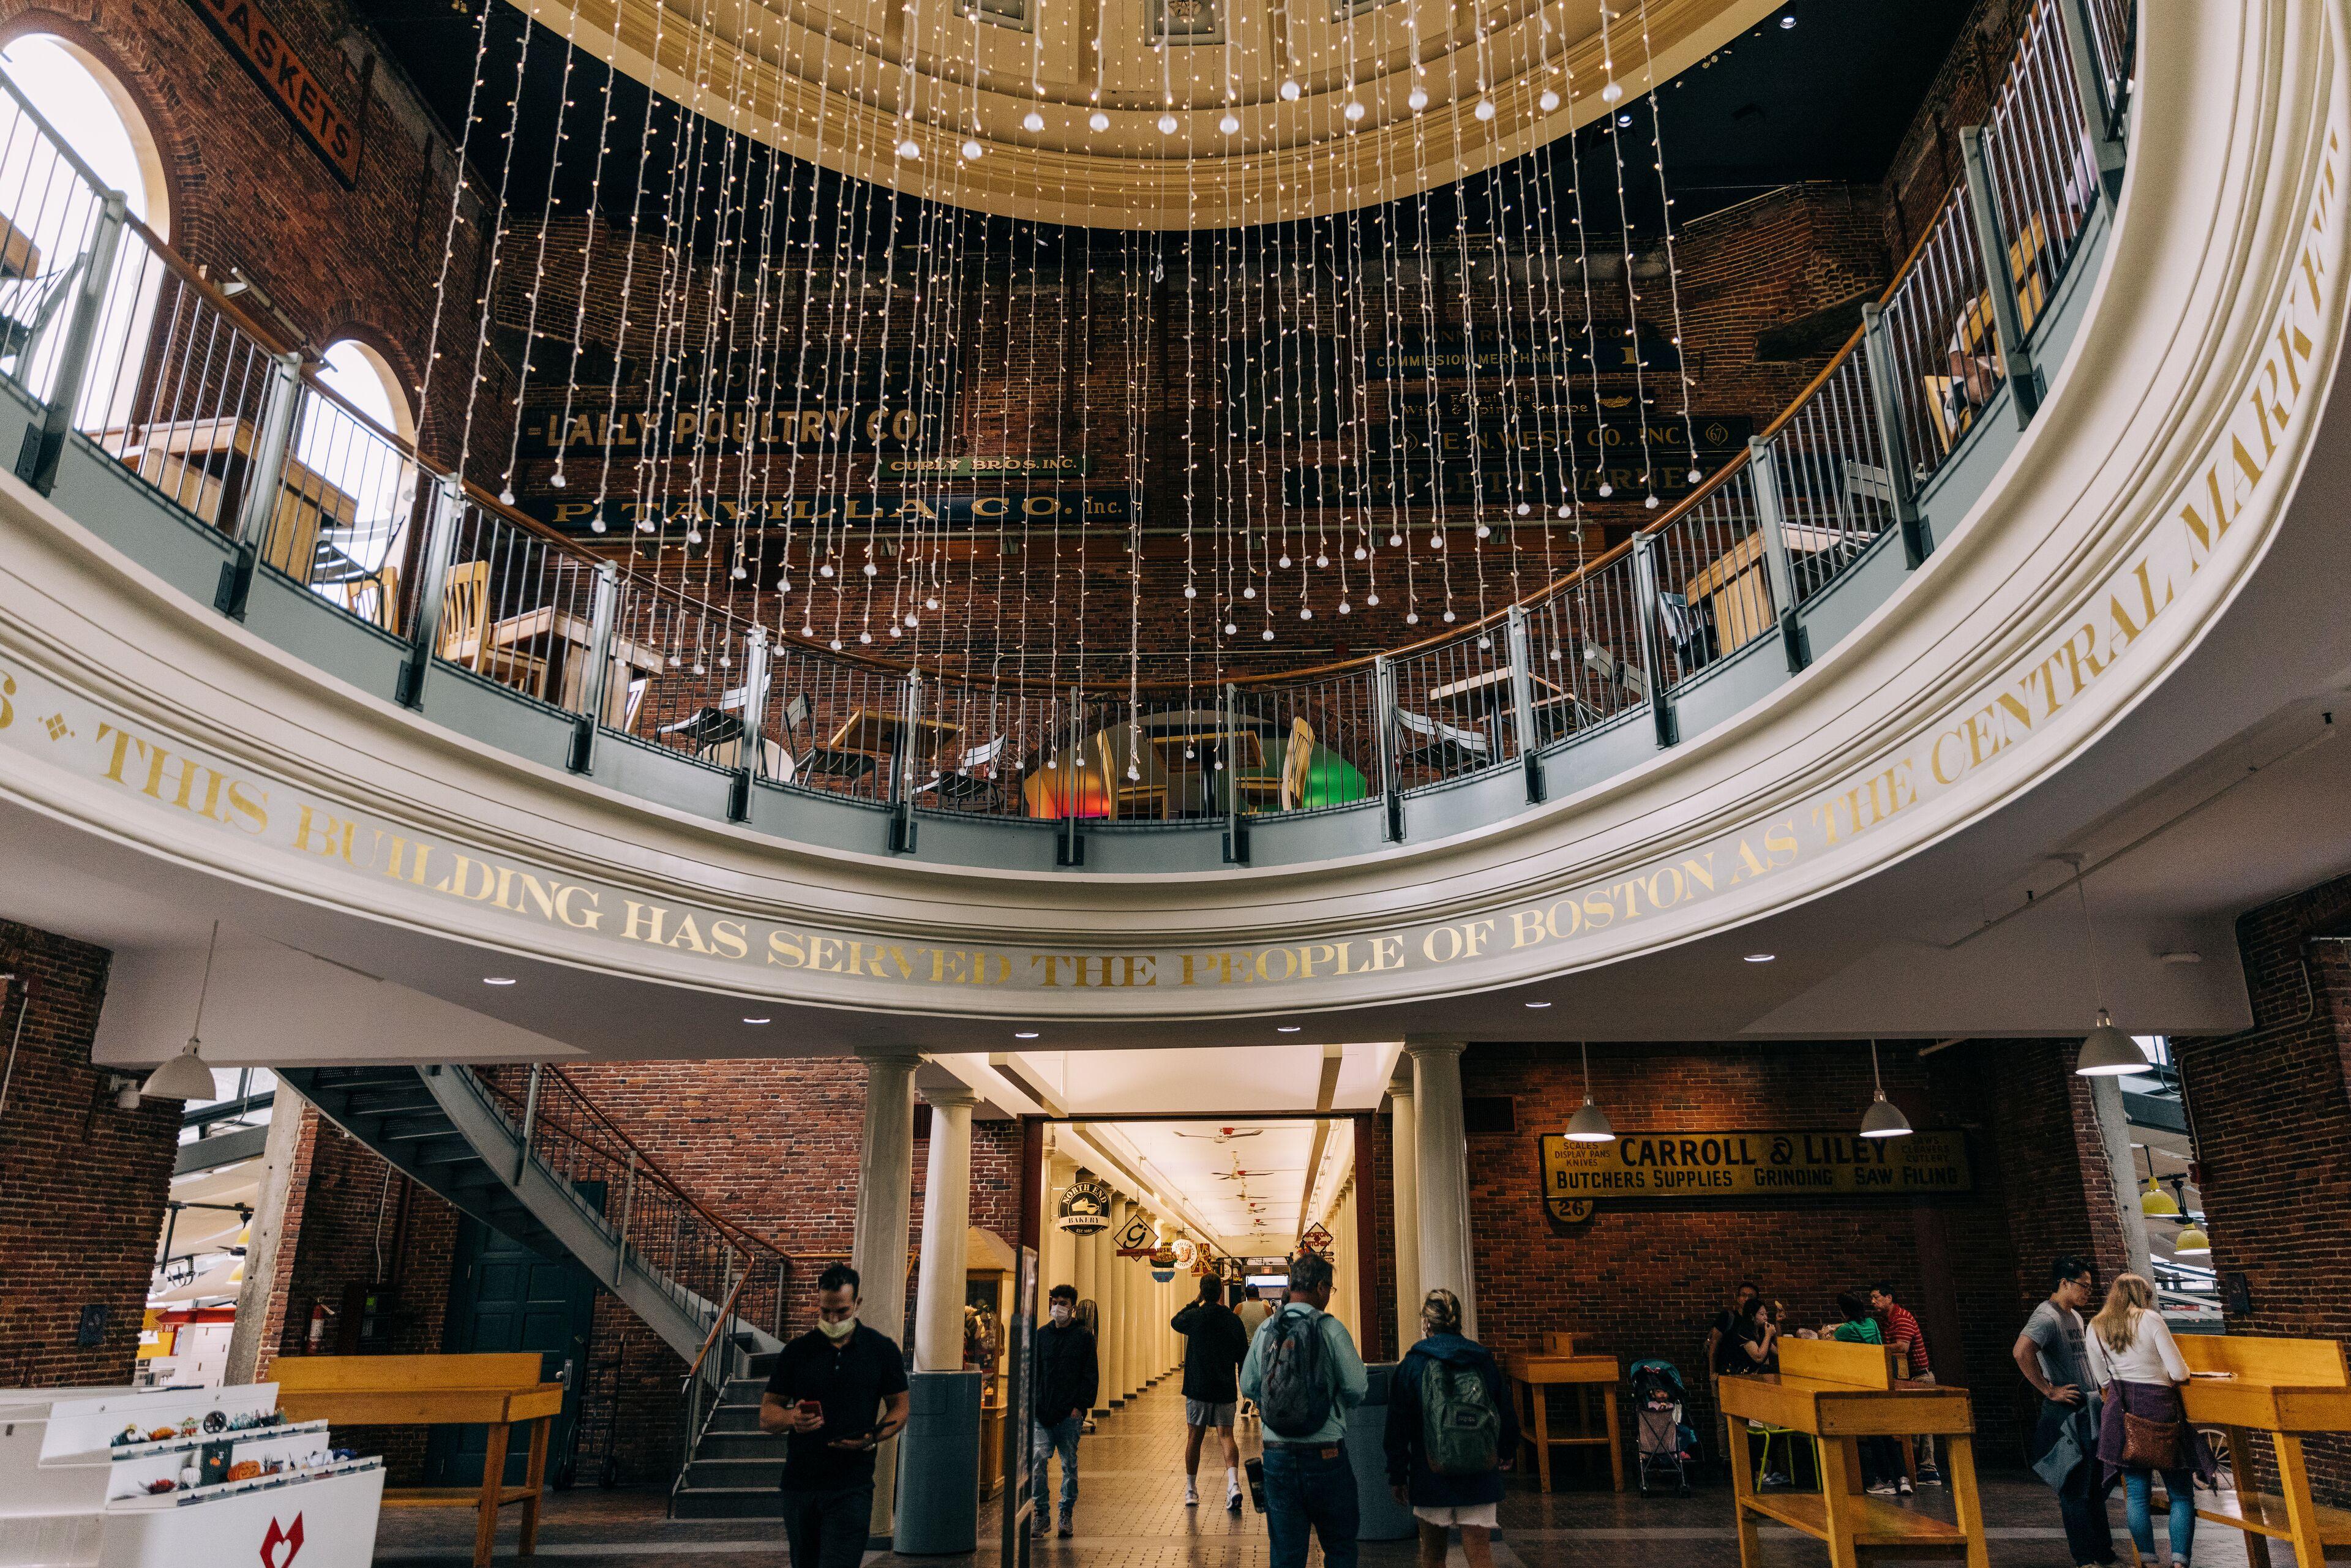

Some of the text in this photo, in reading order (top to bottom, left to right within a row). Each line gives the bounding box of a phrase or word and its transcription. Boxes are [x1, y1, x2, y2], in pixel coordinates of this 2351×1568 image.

[215, 0, 350, 159] ASKETS
[1376, 354, 1468, 367] COMMISSION
[1478, 350, 1570, 366] MERCHANTS
[681, 359, 869, 389] WHOLESALE
[1513, 392, 1539, 403] Hal
[1451, 403, 1462, 415] &
[1531, 400, 1588, 415] Shoppe
[547, 412, 660, 446] LALLY
[675, 409, 850, 444] POULTRY
[1498, 429, 1575, 450] WEST
[1638, 426, 1687, 446] INC.
[890, 457, 1078, 471] CURLY BROS. INC.
[621, 498, 938, 522] TAVILLA
[971, 496, 1073, 516] CO.
[1086, 496, 1122, 514] Inc.
[96, 126, 2338, 987] THIS BUILDING HAS SERVED THE PEOPLE OF BOSTON AS THE CENTRAL MARKET
[1563, 1142, 1599, 1150] SCALES
[1902, 1144, 1950, 1154] CLEAVERS
[1910, 1136, 1939, 1145] SAWS
[1554, 1149, 1611, 1159] DISPLAY PANS
[1620, 1133, 1888, 1167] CARROLL & LILEY
[1905, 1153, 1948, 1163] CUTLERY
[1565, 1158, 1598, 1168] KNIVES
[1556, 1165, 1958, 1189] BUTCHERS SUPPLIES GRINDING SAW FILING
[1062, 1184, 1107, 1204] NORTH END
[1558, 1199, 1584, 1217] 26
